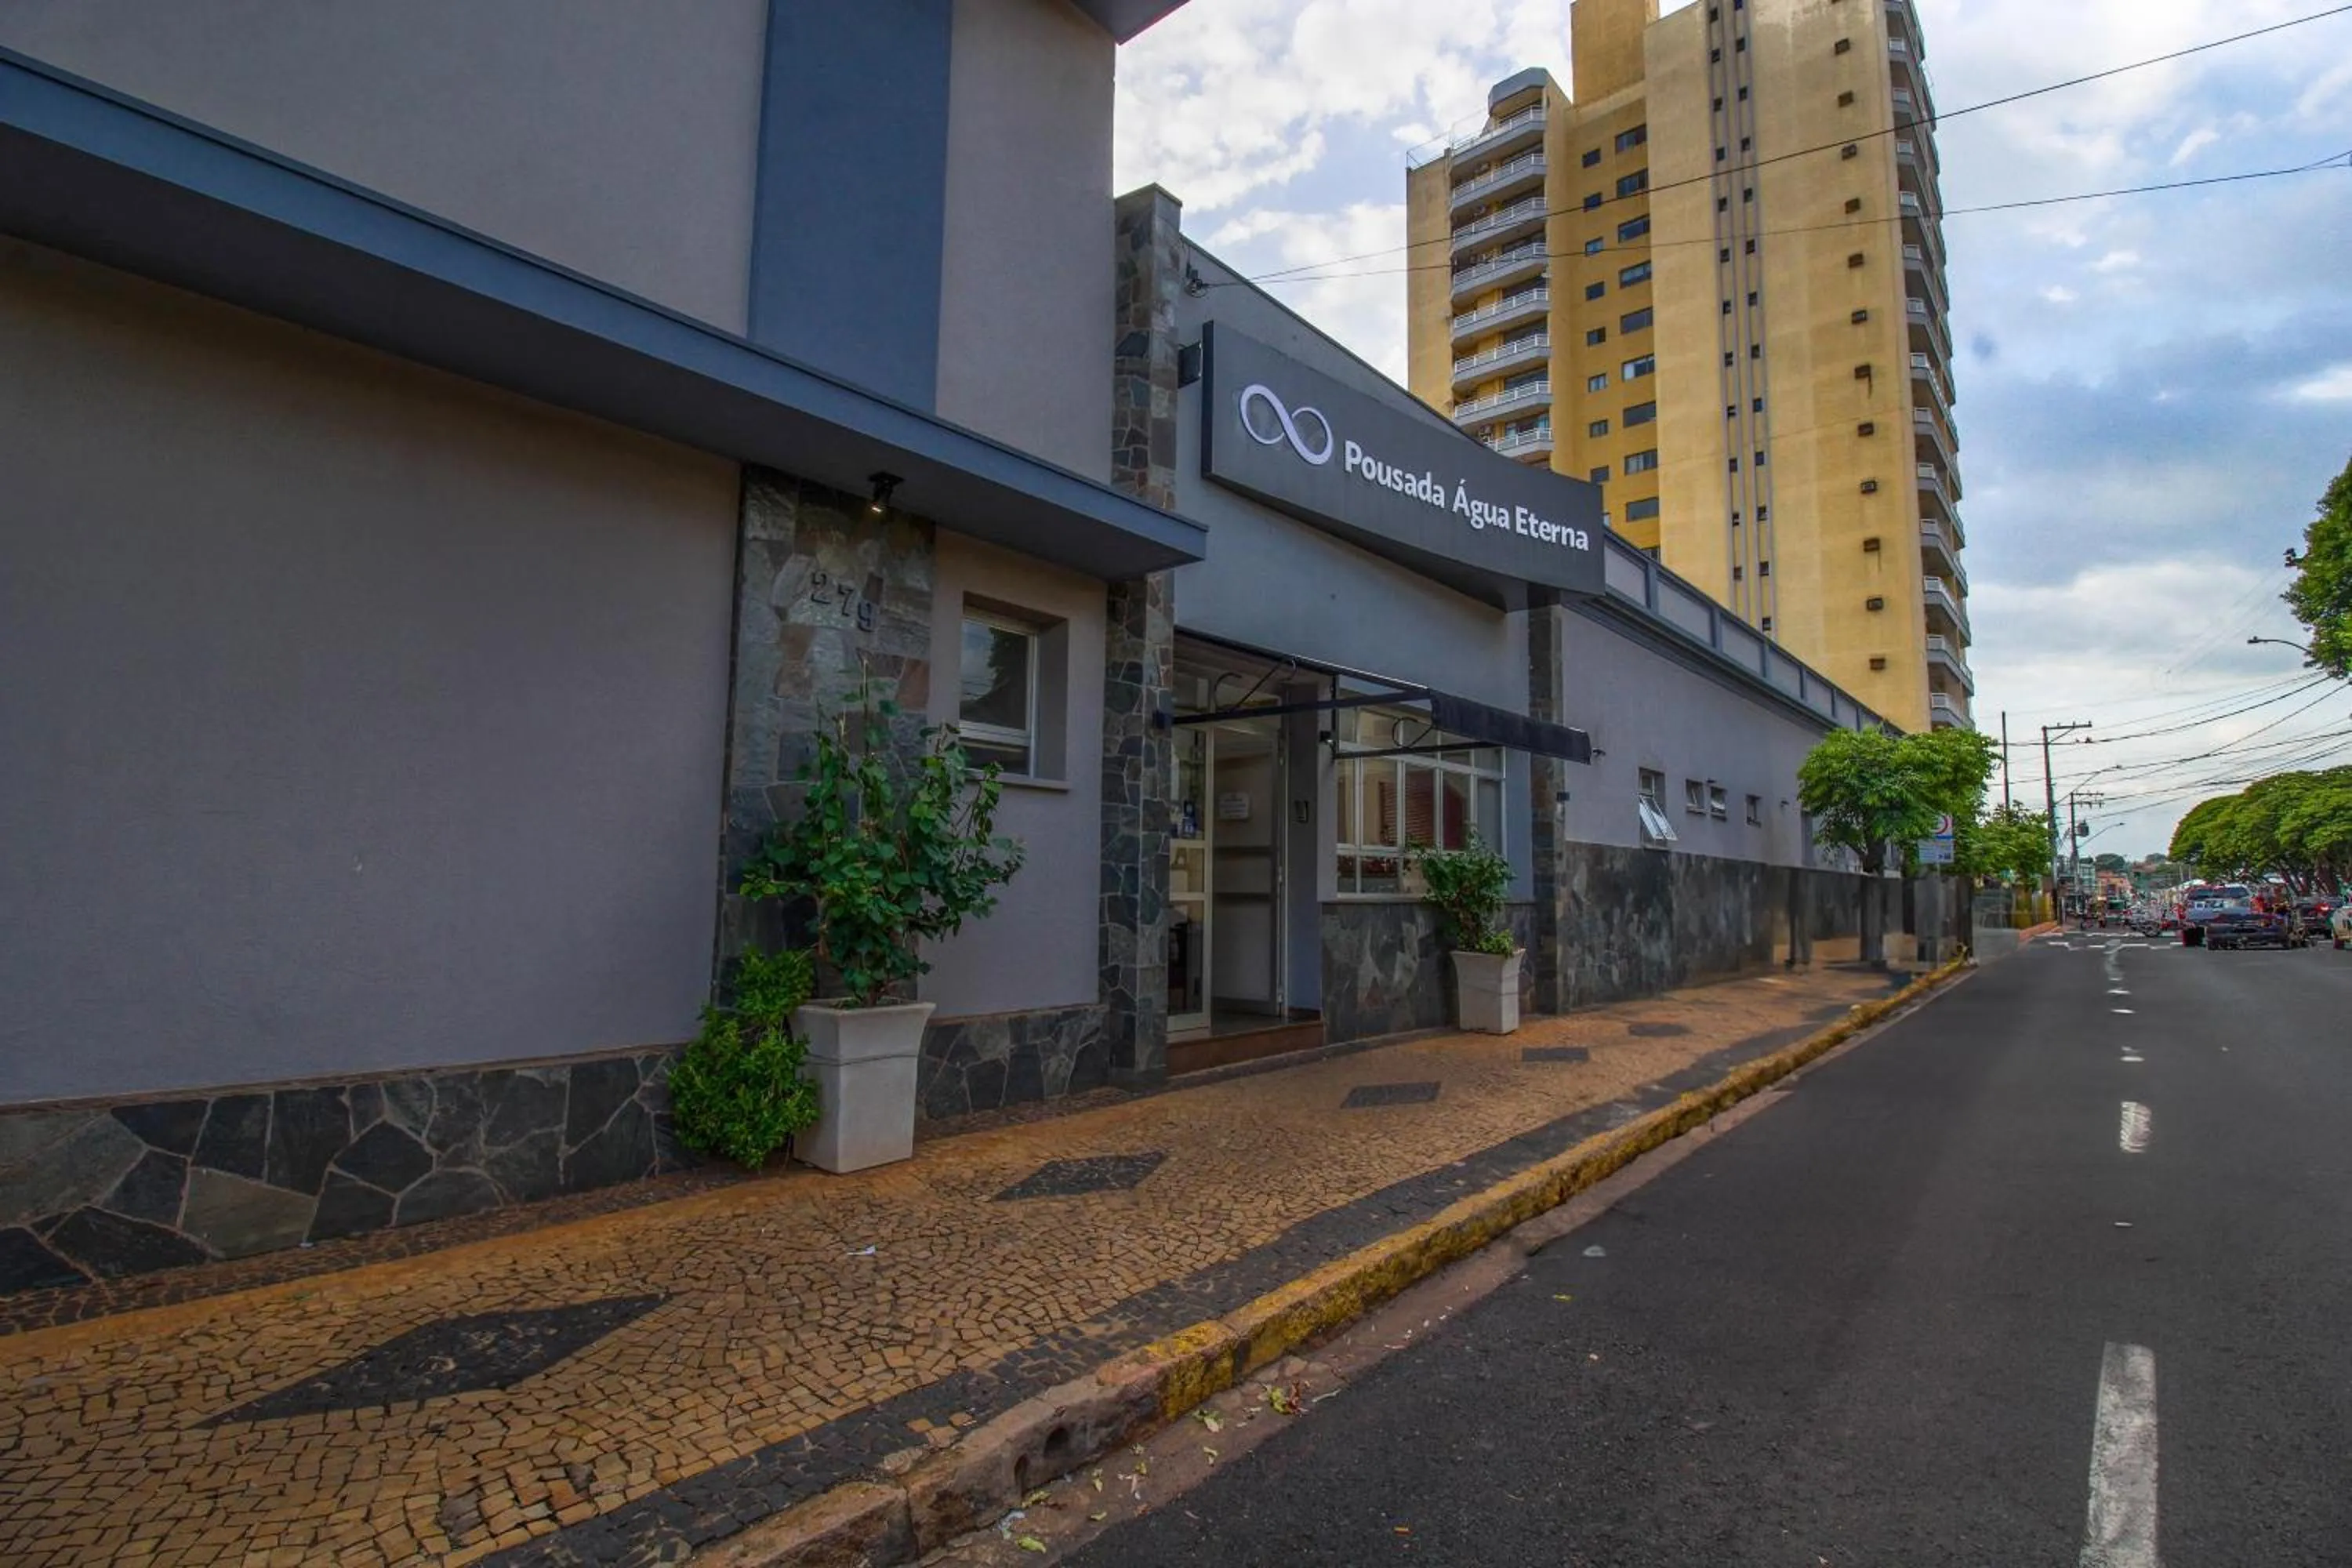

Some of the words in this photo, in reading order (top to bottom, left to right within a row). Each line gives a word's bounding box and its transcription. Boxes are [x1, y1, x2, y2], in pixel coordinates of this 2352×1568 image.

[1343, 440, 1446, 509] Pousada
[1451, 479, 1511, 530] Água
[1515, 505, 1589, 551] Eterna
